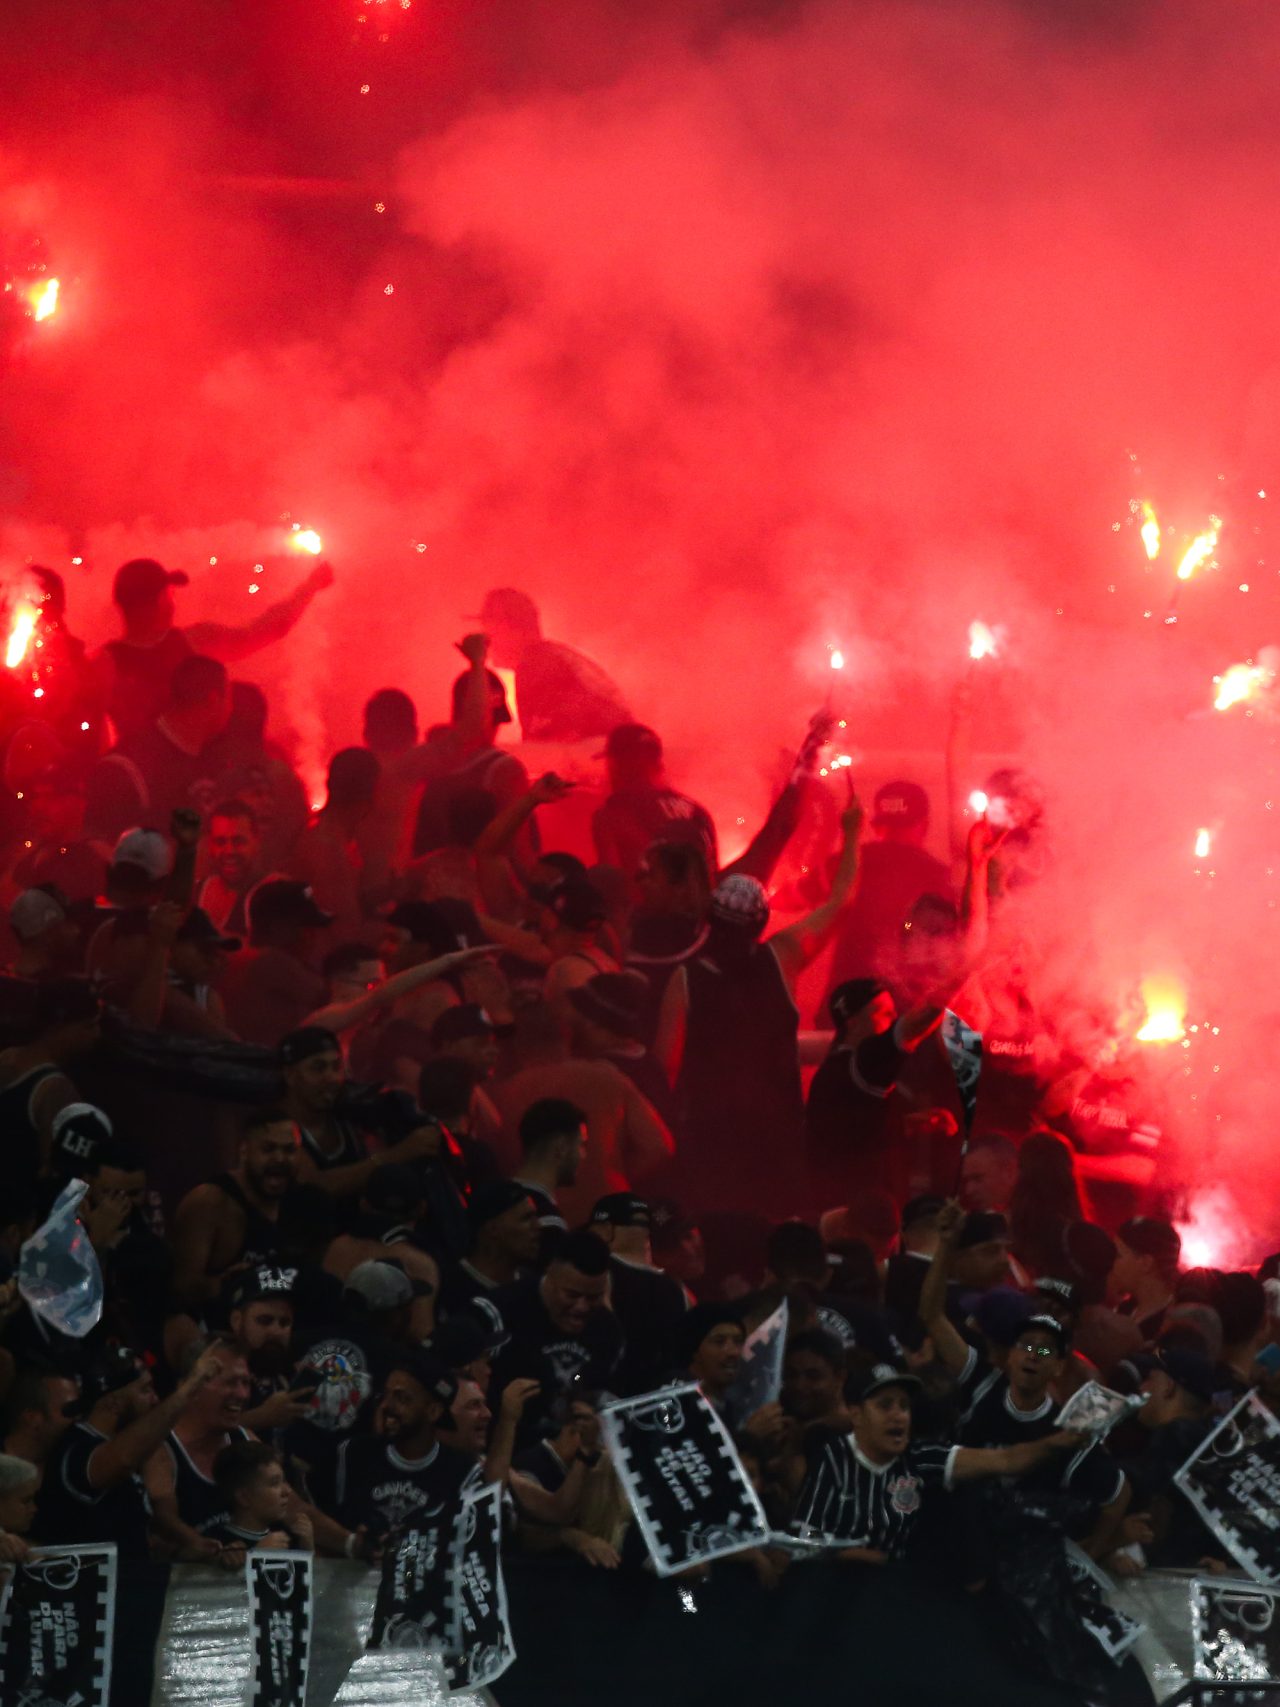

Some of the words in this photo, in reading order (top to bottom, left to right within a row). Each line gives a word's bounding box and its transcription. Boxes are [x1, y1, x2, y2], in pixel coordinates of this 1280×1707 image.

[29, 1610, 45, 1677] LUTAR
[40, 1600, 54, 1631] DE
[52, 1609, 68, 1671] PARA
